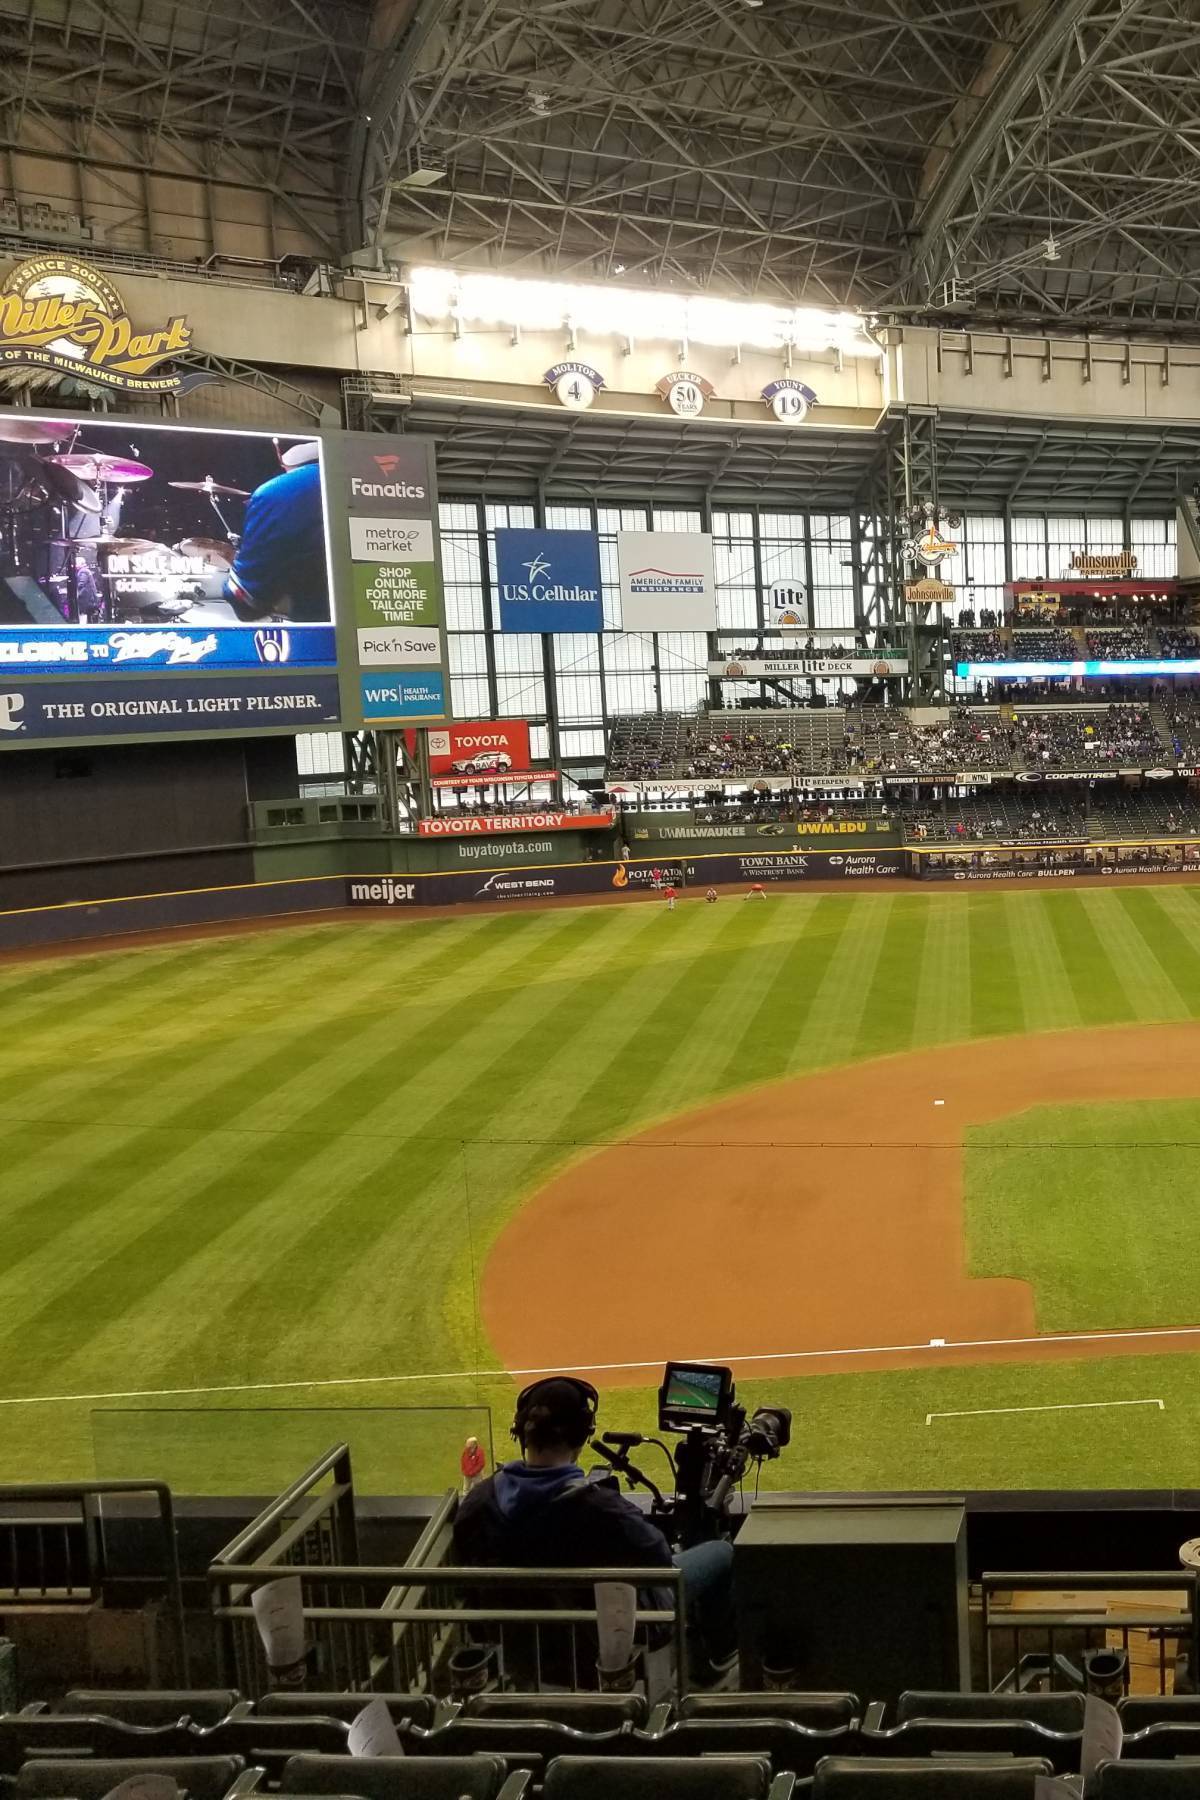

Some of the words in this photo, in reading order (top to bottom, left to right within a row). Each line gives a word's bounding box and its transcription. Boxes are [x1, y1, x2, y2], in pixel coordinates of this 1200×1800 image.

[22, 261, 66, 279] SINCE
[71, 264, 103, 287] 2001
[72, 313, 192, 365] Park
[5, 350, 21, 360] OF
[25, 350, 50, 363] THE
[54, 356, 124, 387] MILWAUKEE
[127, 377, 181, 390] BREWERS
[552, 363, 596, 379] MOLITOR
[567, 380, 580, 402] 4
[774, 381, 804, 392] YOUNT
[676, 386, 697, 403] 50
[779, 396, 802, 416] 19
[352, 478, 425, 498] Fanatics
[366, 528, 406, 539] metro
[366, 540, 412, 552] market
[1068, 550, 1138, 569] Johnsonville
[378, 567, 412, 578] SHOP
[374, 578, 418, 589] ONLINE
[366, 589, 390, 600] FOR
[392, 589, 428, 600] MORE
[502, 584, 531, 601] U.S.
[532, 584, 598, 602] Cellular
[774, 588, 803, 610] Lite
[908, 587, 954, 600] Johnsonville
[370, 600, 424, 611] TAILGATE
[382, 610, 414, 622] TIME!
[0, 640, 88, 662] ELCOME
[363, 641, 391, 653] Pick
[404, 640, 436, 652] Save
[764, 663, 800, 672] MILLER
[828, 662, 852, 670] DECK
[365, 688, 399, 702] WPS
[404, 694, 442, 702] INSURANCE
[42, 703, 86, 720] THE
[90, 699, 182, 718] ORIGINAL
[186, 697, 242, 714] LIGHT
[246, 694, 322, 712] PILSNER.
[454, 734, 508, 748] TOYOTA
[422, 820, 482, 833] TOYOTA
[484, 814, 564, 830] TERRITORY
[797, 822, 867, 834] UWM.EDU
[458, 841, 553, 858] buyatoyota.com
[738, 856, 774, 867] TOWN
[776, 856, 808, 866] BANK
[845, 856, 876, 864] Aurora
[844, 865, 874, 875] Health
[876, 864, 896, 874] Care
[992, 870, 1016, 878] Health
[1038, 869, 1075, 877] BULLPEN
[1138, 865, 1161, 873] Health
[352, 878, 415, 904] meijer
[494, 881, 524, 890] WEST
[526, 880, 554, 888] BEND
